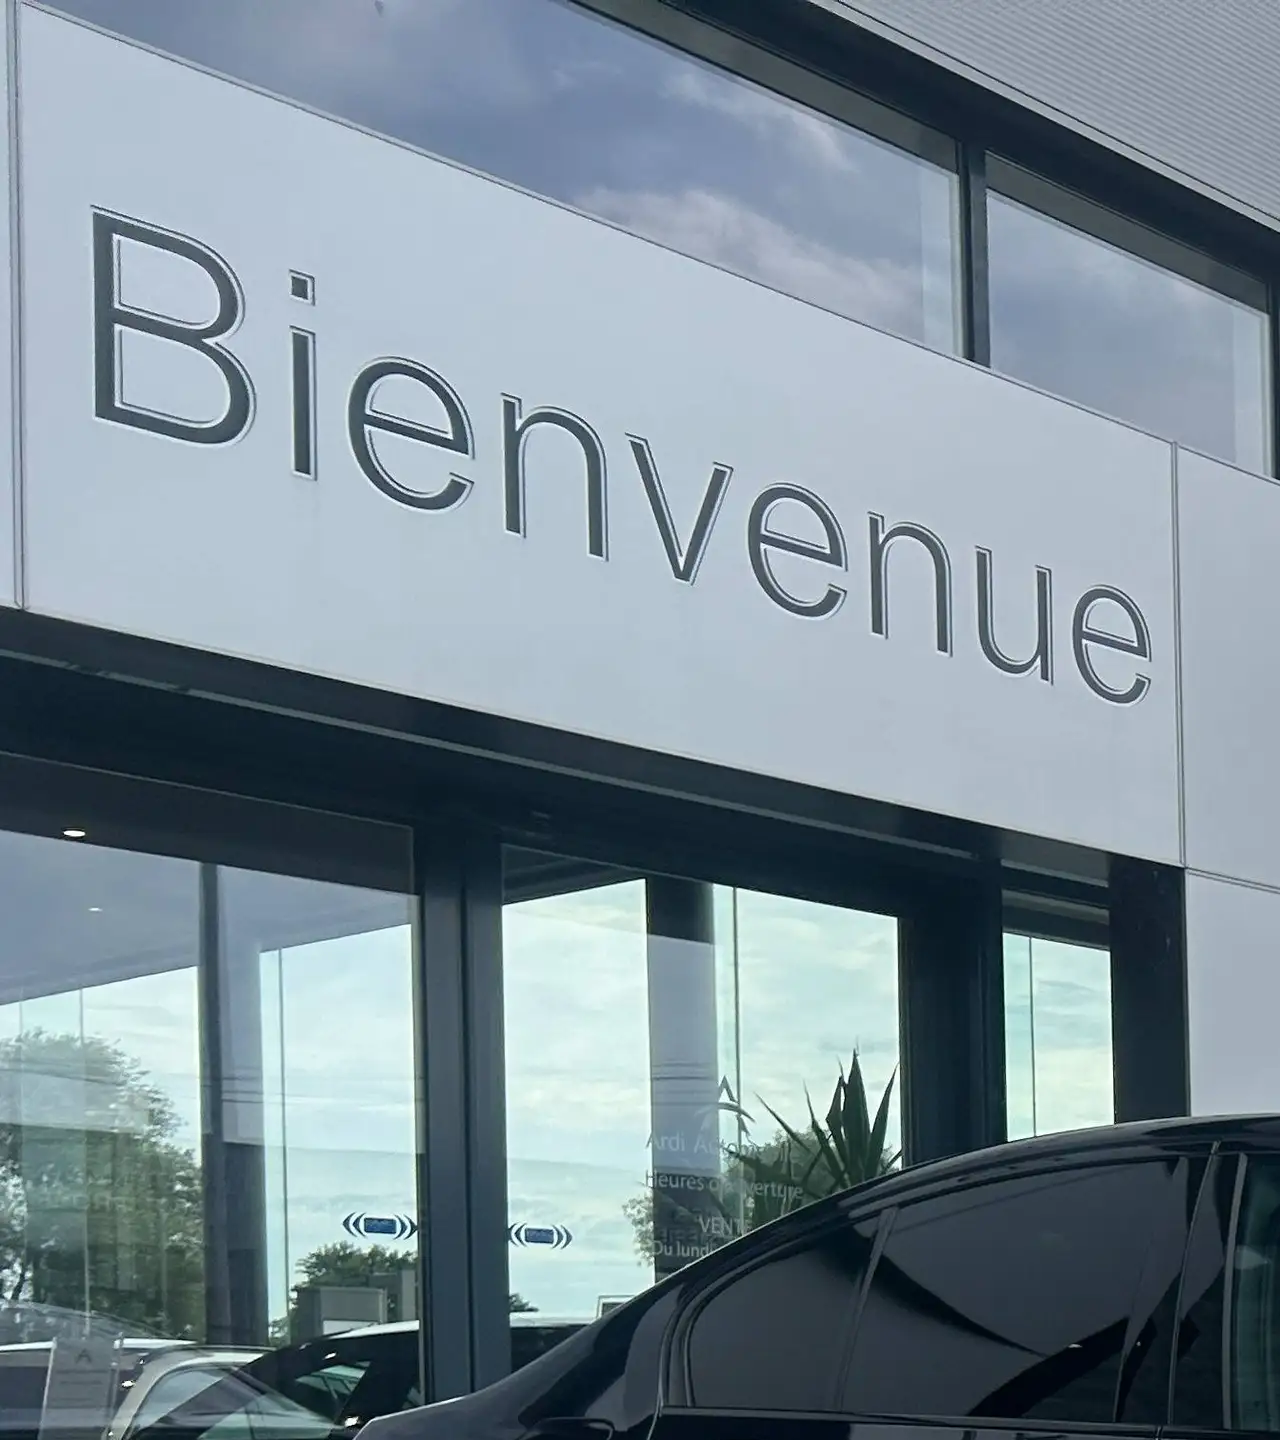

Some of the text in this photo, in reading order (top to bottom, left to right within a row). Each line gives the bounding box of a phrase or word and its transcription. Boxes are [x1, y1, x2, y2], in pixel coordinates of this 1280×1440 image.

[92, 204, 1152, 706] Bienvenue
[646, 1130, 800, 1163] Ardi Automo
[646, 1169, 804, 1199] Heures doverture
[651, 1240, 673, 1256] Du
